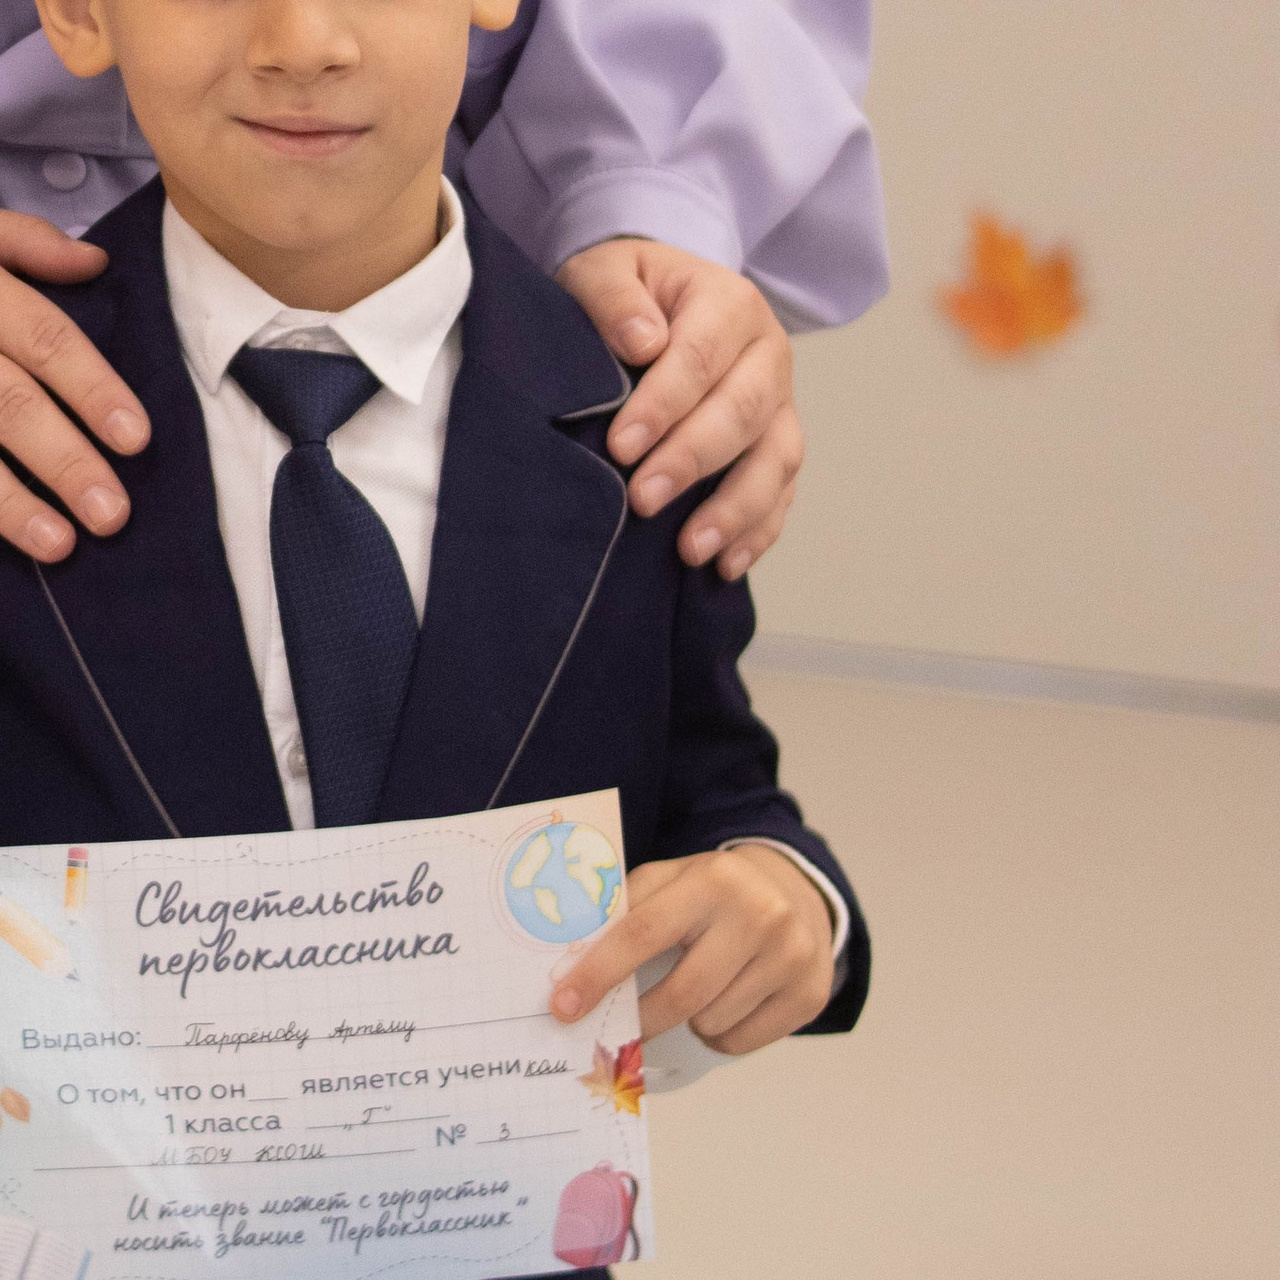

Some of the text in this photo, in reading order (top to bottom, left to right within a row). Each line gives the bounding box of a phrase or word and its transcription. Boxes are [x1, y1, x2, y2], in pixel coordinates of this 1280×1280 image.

[135, 861, 444, 948] Свидетельство
[138, 928, 461, 999] первоклассника
[21, 1029, 142, 1052] Выдано:
[56, 1082, 80, 1106] О
[87, 1087, 147, 1107] том,
[154, 1084, 203, 1102] что
[209, 1083, 246, 1100] он
[301, 1068, 430, 1095] является
[164, 1113, 175, 1135] 1
[184, 1114, 282, 1135] класса
[435, 1122, 468, 1148] №
[497, 1121, 512, 1142] 3
[125, 1179, 510, 1232] И теперь может с гордостью
[112, 1230, 205, 1253] носить
[214, 1219, 306, 1260] звание
